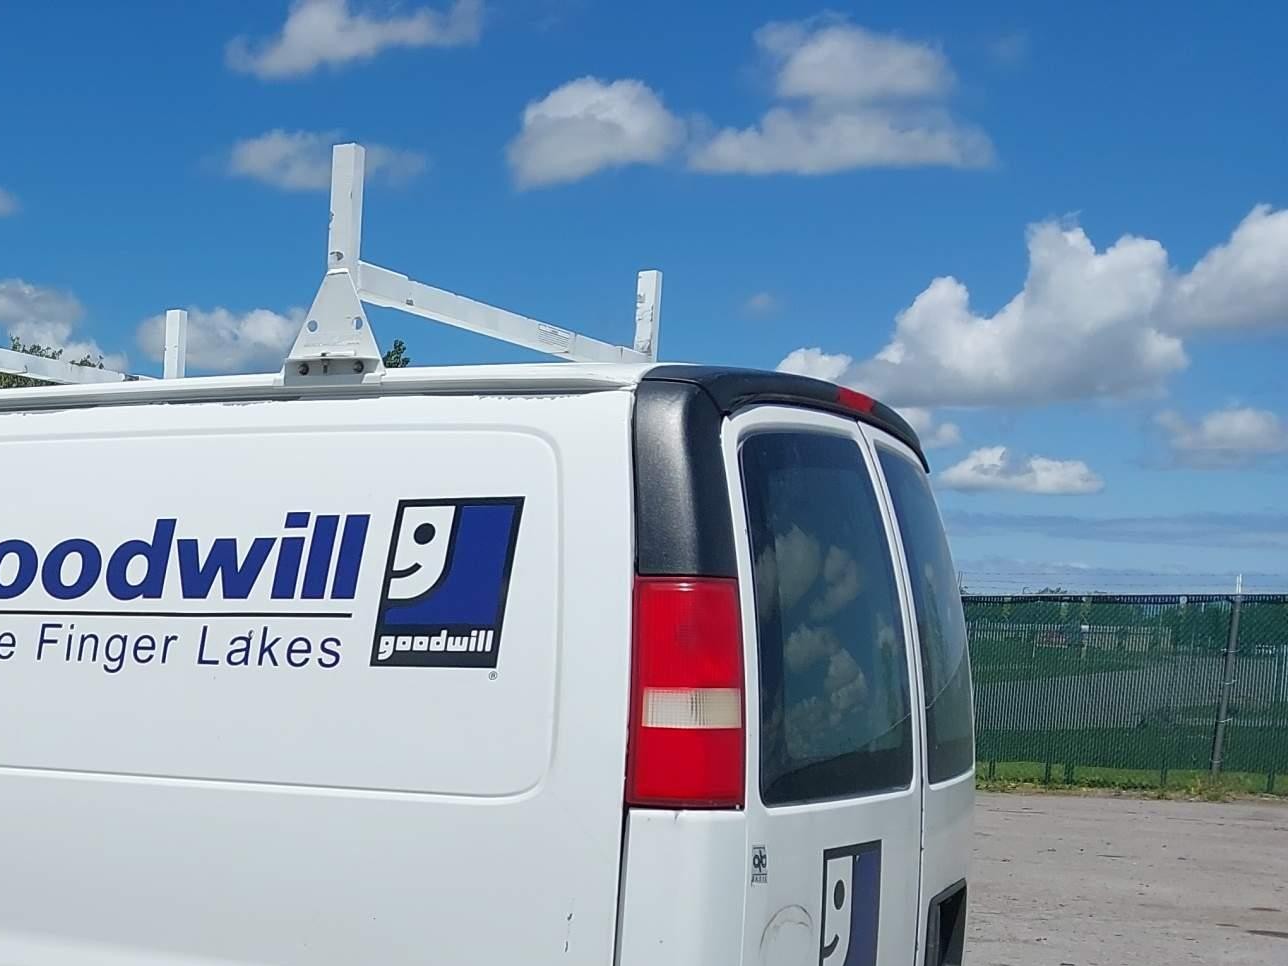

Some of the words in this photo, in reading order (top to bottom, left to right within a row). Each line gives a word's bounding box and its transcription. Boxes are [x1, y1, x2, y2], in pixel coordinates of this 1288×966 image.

[36, 623, 178, 673] Finger
[197, 625, 342, 668] Lakes
[377, 629, 494, 661] goodwill
